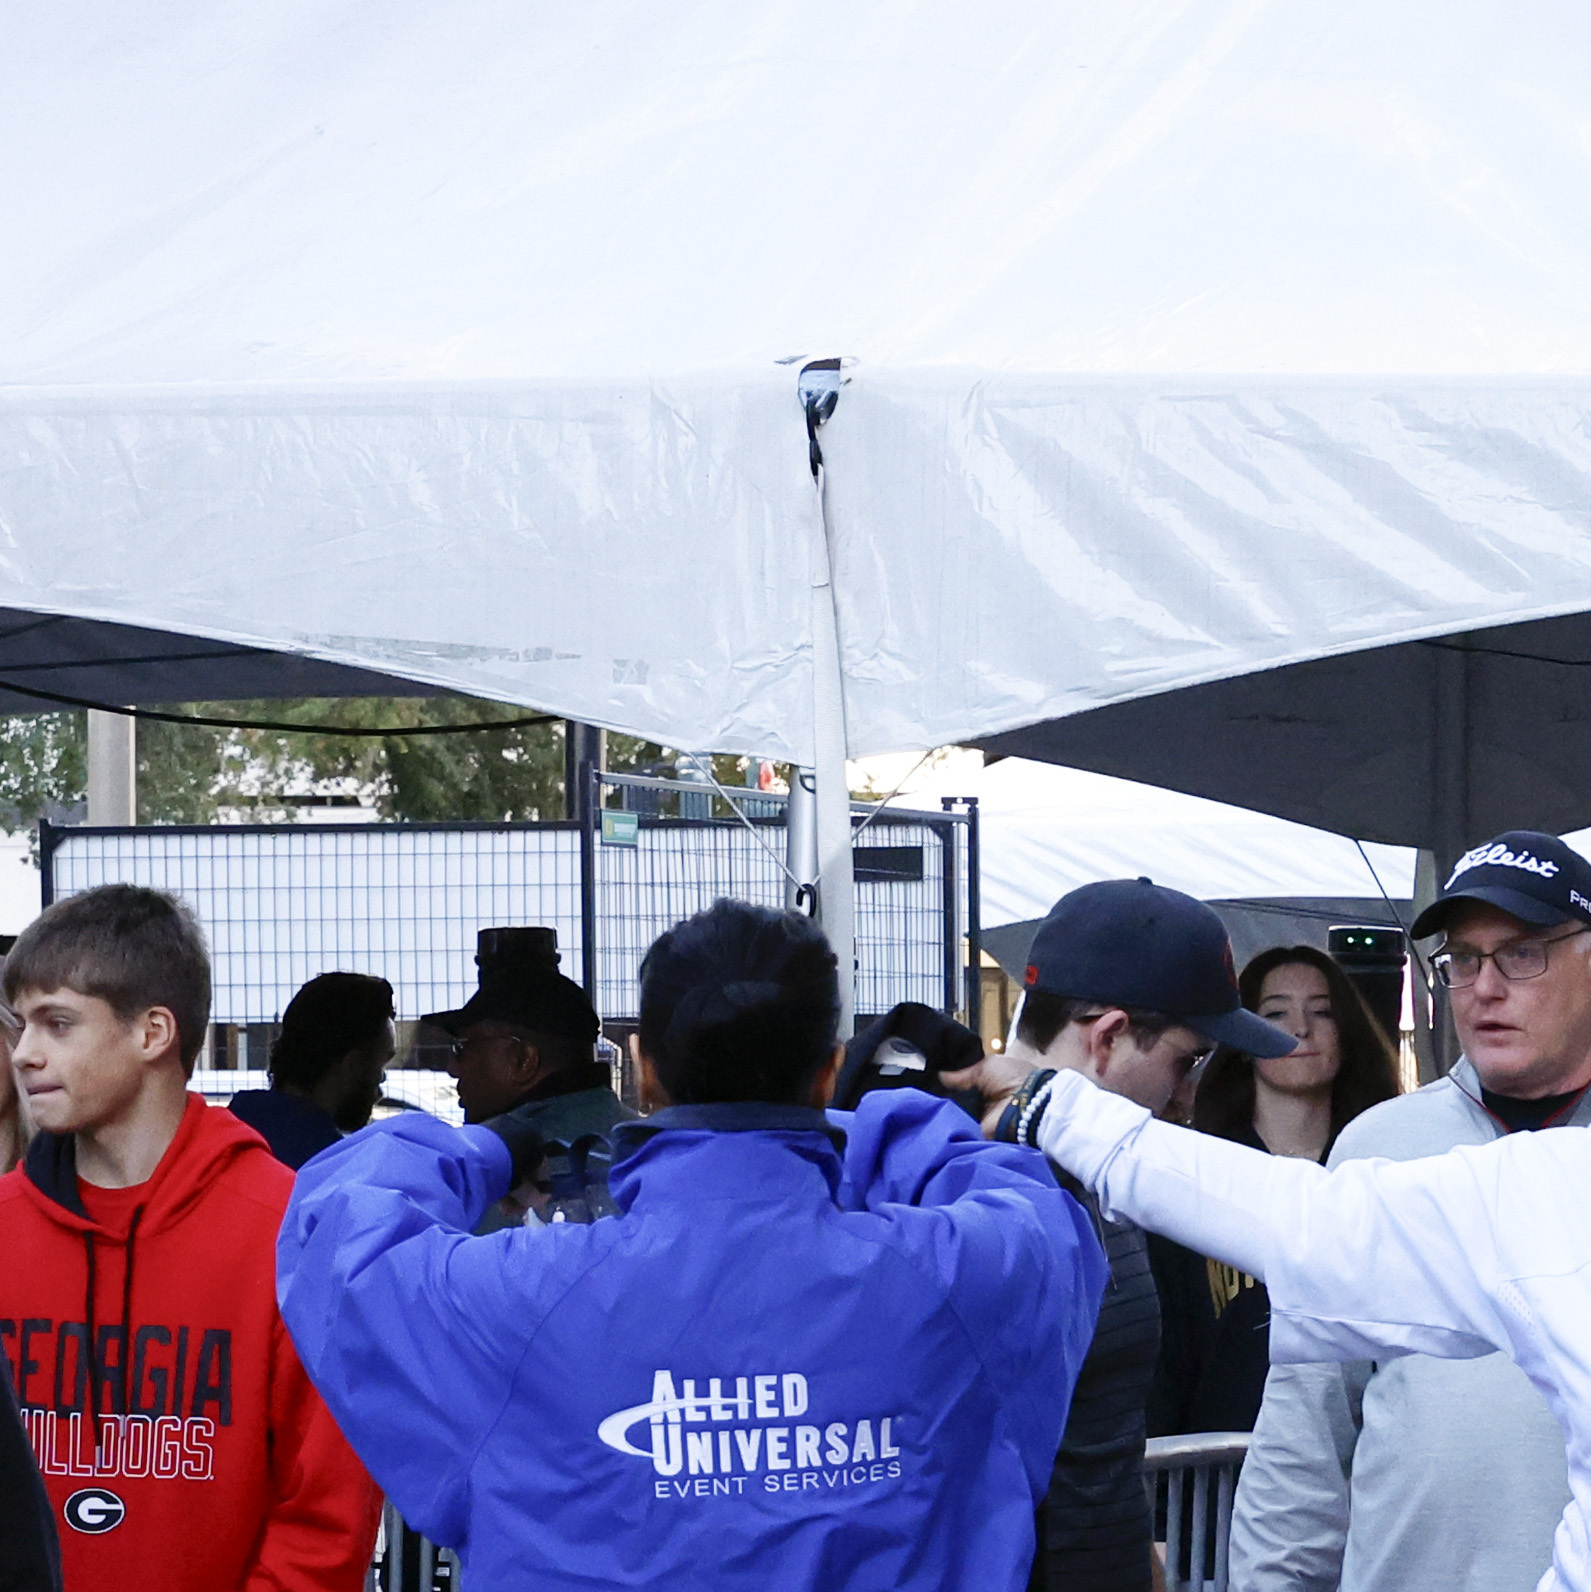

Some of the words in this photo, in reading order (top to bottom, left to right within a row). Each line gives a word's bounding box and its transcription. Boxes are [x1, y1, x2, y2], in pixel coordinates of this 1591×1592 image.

[1444, 843, 1559, 890] Titleist
[0, 1318, 232, 1426] EORGIA
[650, 1370, 809, 1425] ALLIED
[20, 1408, 214, 1480] ULLDOGS
[651, 1417, 900, 1476] UNIVERSAL
[655, 1477, 748, 1499] EVENT
[764, 1462, 902, 1492] SERVICES
[68, 1491, 124, 1530] G
